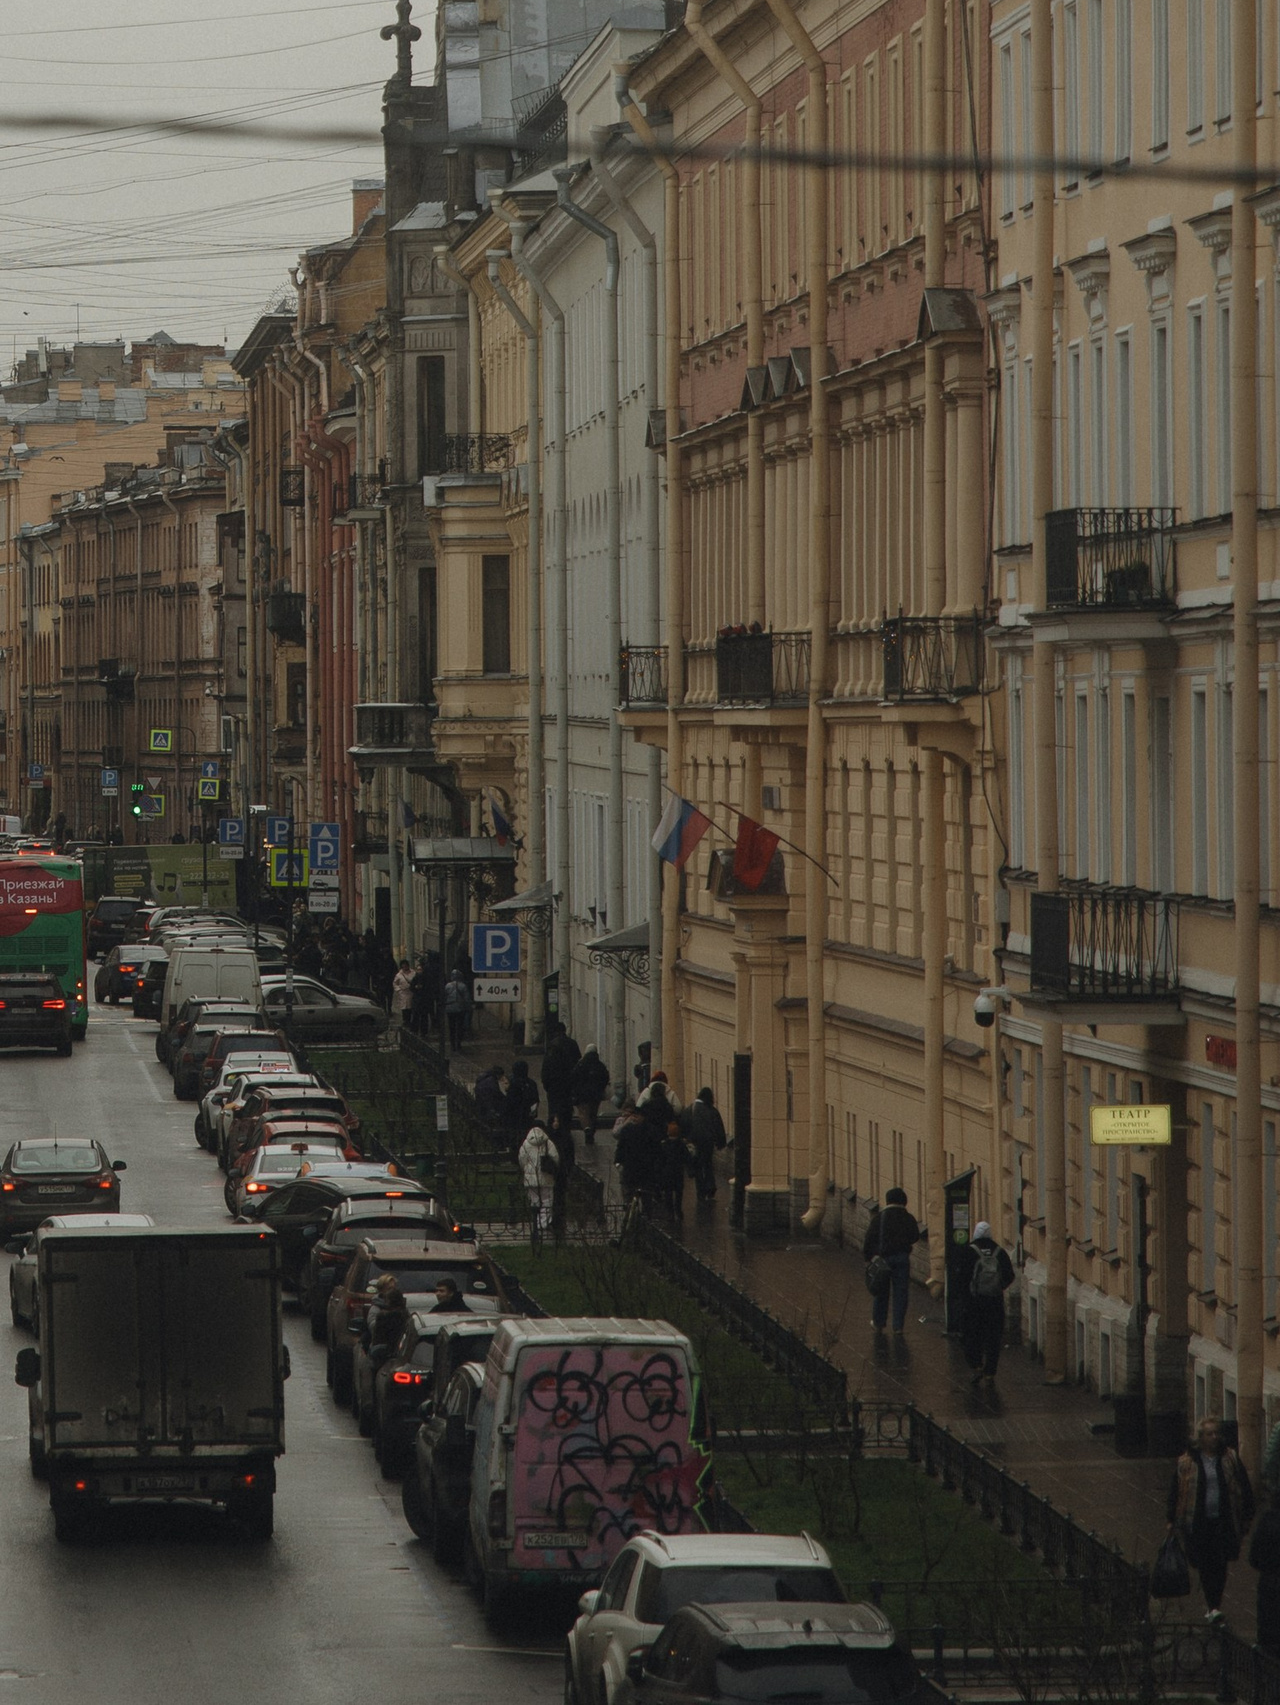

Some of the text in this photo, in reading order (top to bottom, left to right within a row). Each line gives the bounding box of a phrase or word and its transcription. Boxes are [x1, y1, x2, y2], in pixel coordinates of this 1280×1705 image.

[106, 772, 115, 785] P
[227, 822, 240, 841] P
[274, 820, 290, 843] P
[317, 841, 335, 866] P
[7, 891, 57, 904] Казань!
[310, 900, 337, 908] 8.00-20.00
[485, 929, 512, 967] P
[487, 985, 508, 995] 40м
[1109, 1109, 1151, 1119] ТЕАТР
